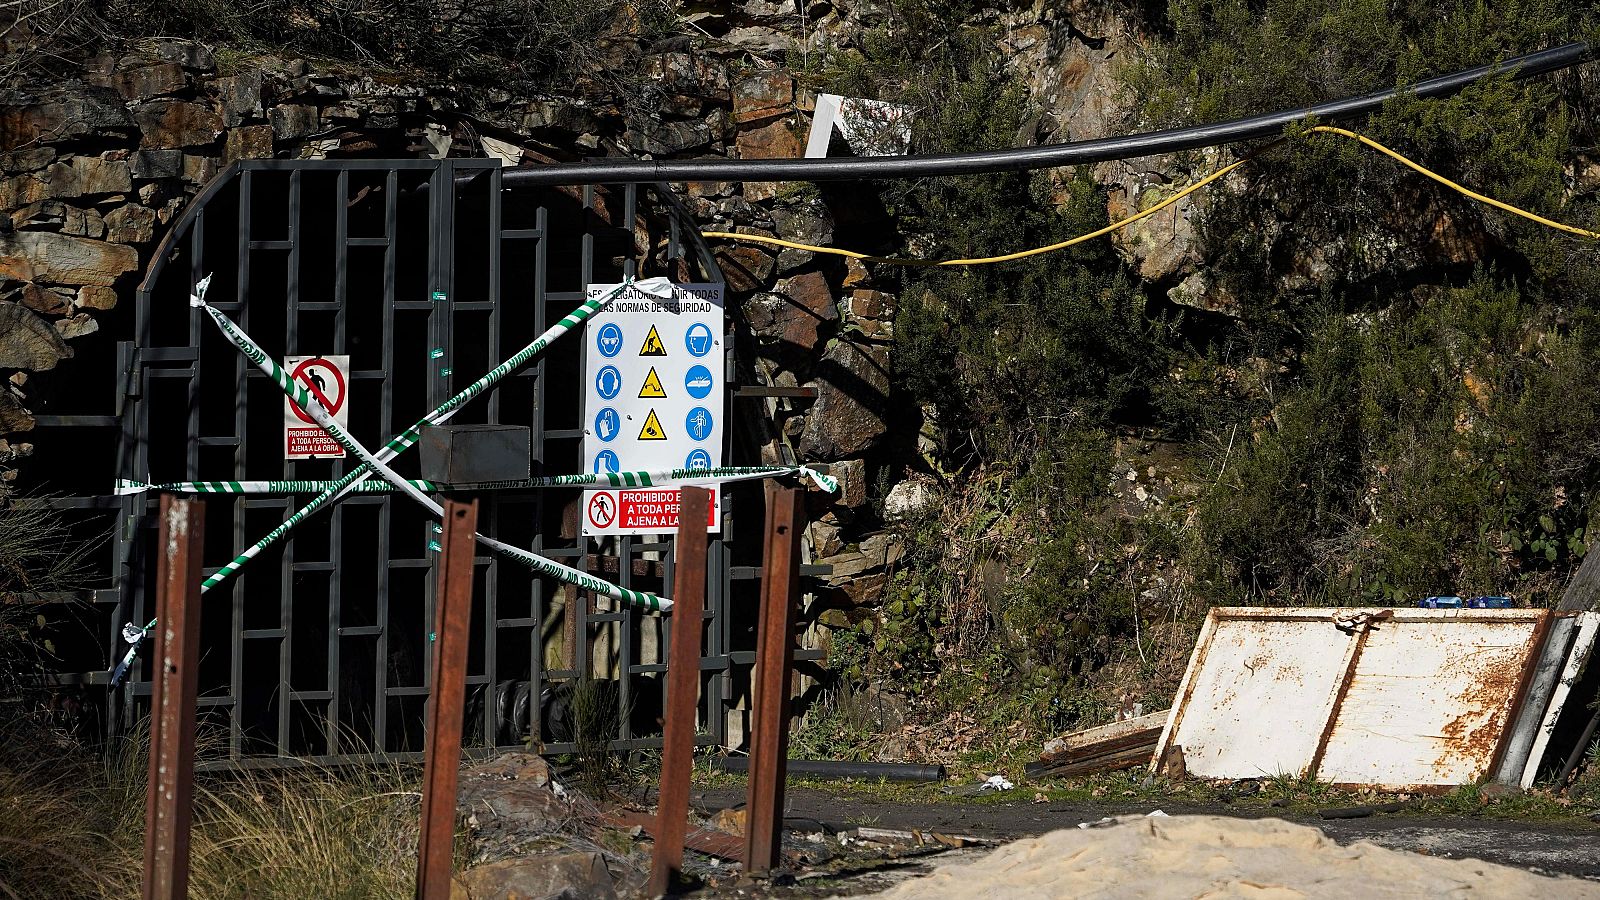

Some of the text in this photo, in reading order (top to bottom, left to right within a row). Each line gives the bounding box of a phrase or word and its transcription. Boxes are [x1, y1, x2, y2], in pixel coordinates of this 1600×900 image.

[690, 290, 718, 300] TODAS
[616, 302, 650, 312] NORMAS
[652, 302, 662, 312] DE
[664, 302, 711, 312] SEGURIDAD
[268, 480, 312, 492] GUARDIA
[550, 476, 563, 486] NO
[622, 492, 674, 502] PROHIBIDO
[628, 504, 634, 514] A
[636, 504, 662, 514] TODA
[626, 516, 680, 526] AJENA A LA
